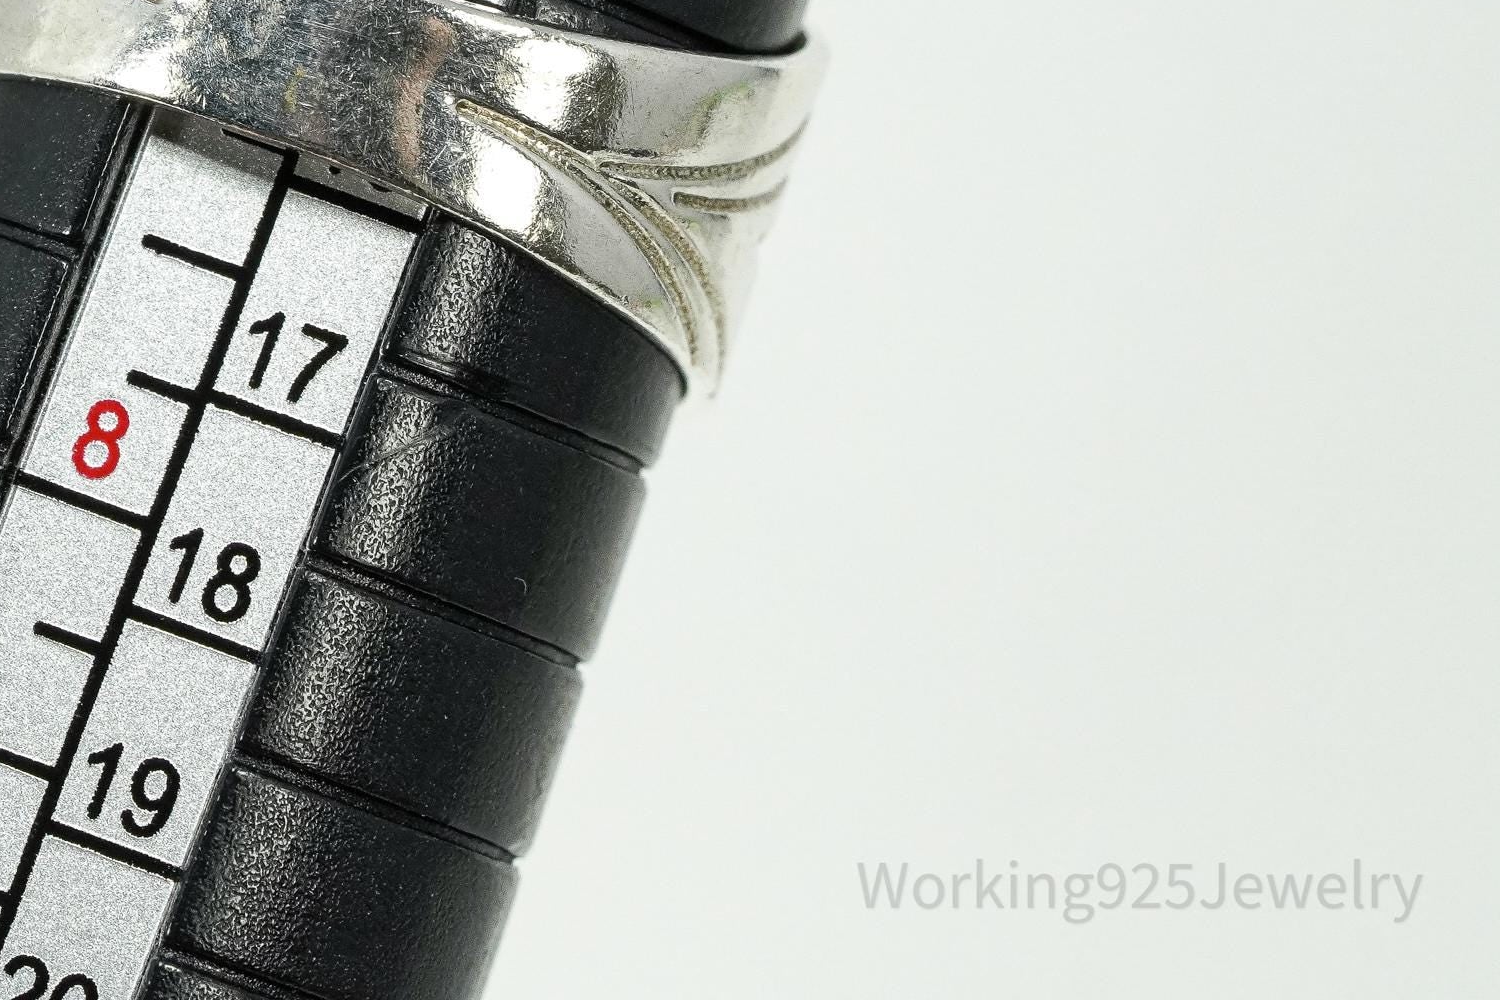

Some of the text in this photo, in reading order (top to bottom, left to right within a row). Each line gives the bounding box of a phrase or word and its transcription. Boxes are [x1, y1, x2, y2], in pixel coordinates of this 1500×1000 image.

[248, 310, 349, 404] 17
[71, 399, 130, 481] 8
[167, 527, 262, 624] 18
[86, 742, 181, 839] 19
